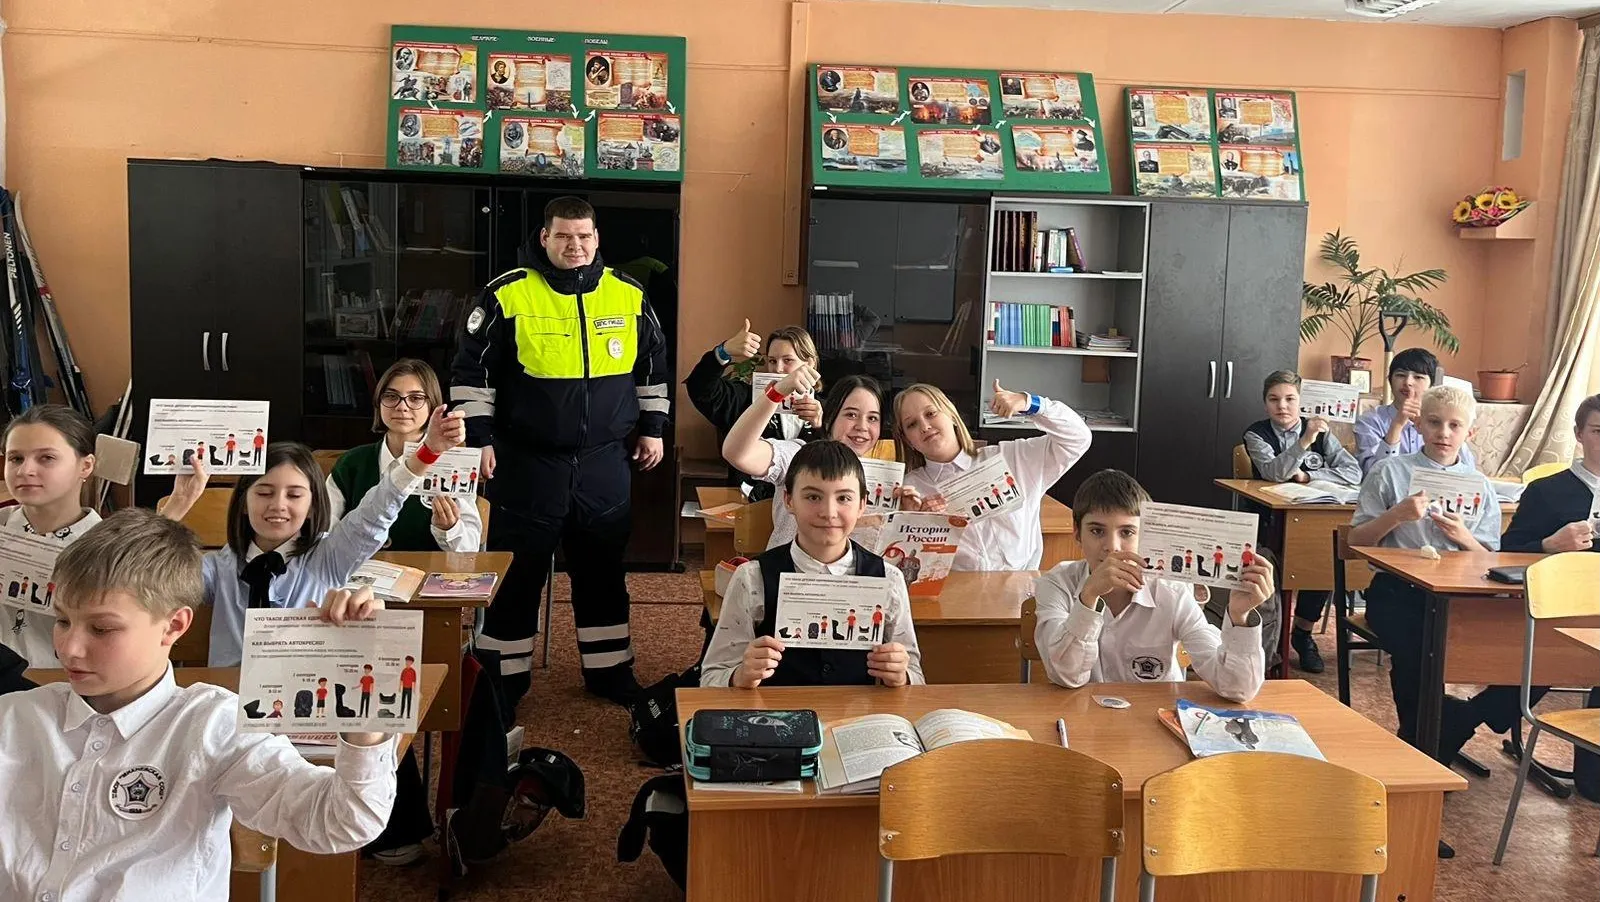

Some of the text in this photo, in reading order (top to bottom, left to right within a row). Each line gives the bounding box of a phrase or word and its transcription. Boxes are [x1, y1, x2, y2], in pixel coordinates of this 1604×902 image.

[3, 232, 18, 280] PELTONEN
[898, 525, 951, 536] История
[906, 534, 948, 543] России
